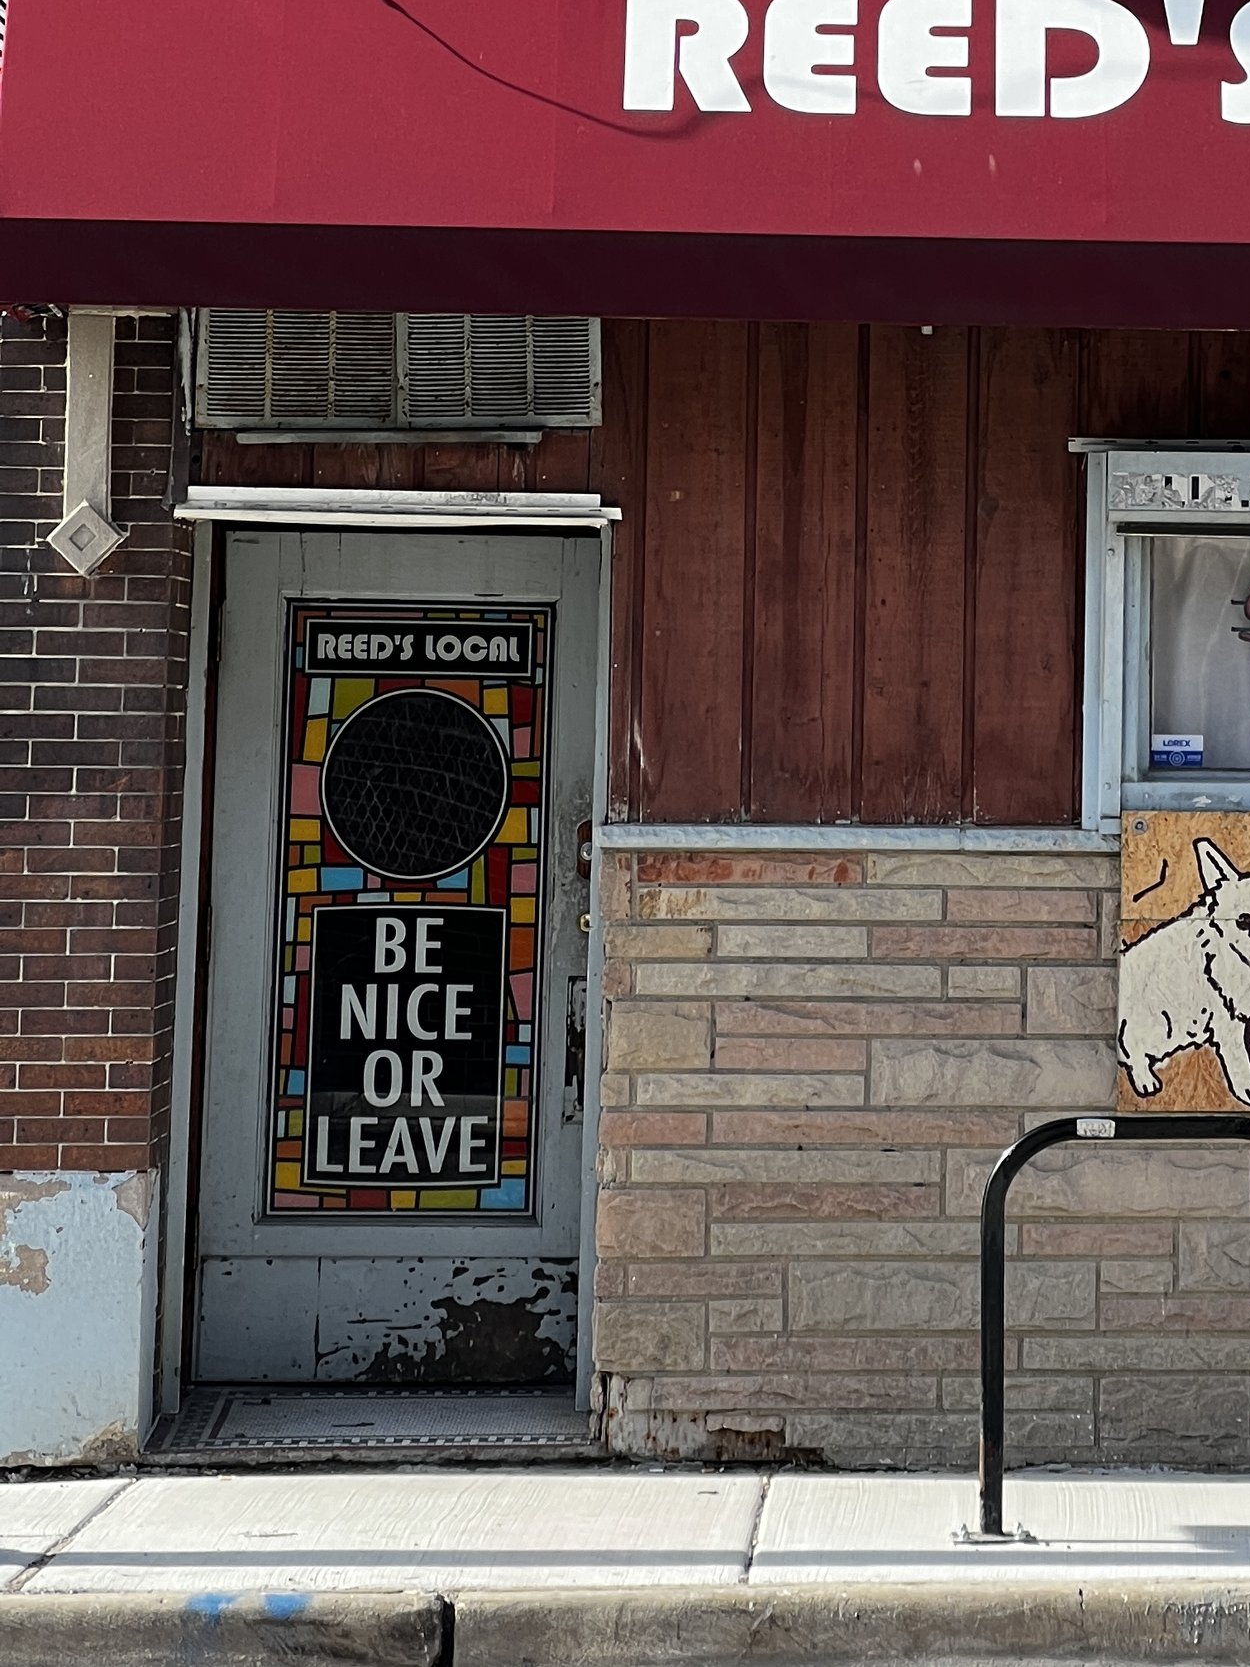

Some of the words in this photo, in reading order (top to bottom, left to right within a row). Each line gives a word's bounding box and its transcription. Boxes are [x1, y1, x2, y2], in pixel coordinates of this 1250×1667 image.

[316, 633, 415, 661] REED'S
[425, 634, 521, 662] LOCAL
[374, 917, 445, 974] BE
[339, 983, 474, 1041] NICE
[362, 1049, 446, 1108] OR
[315, 1115, 489, 1174] LEAVE
